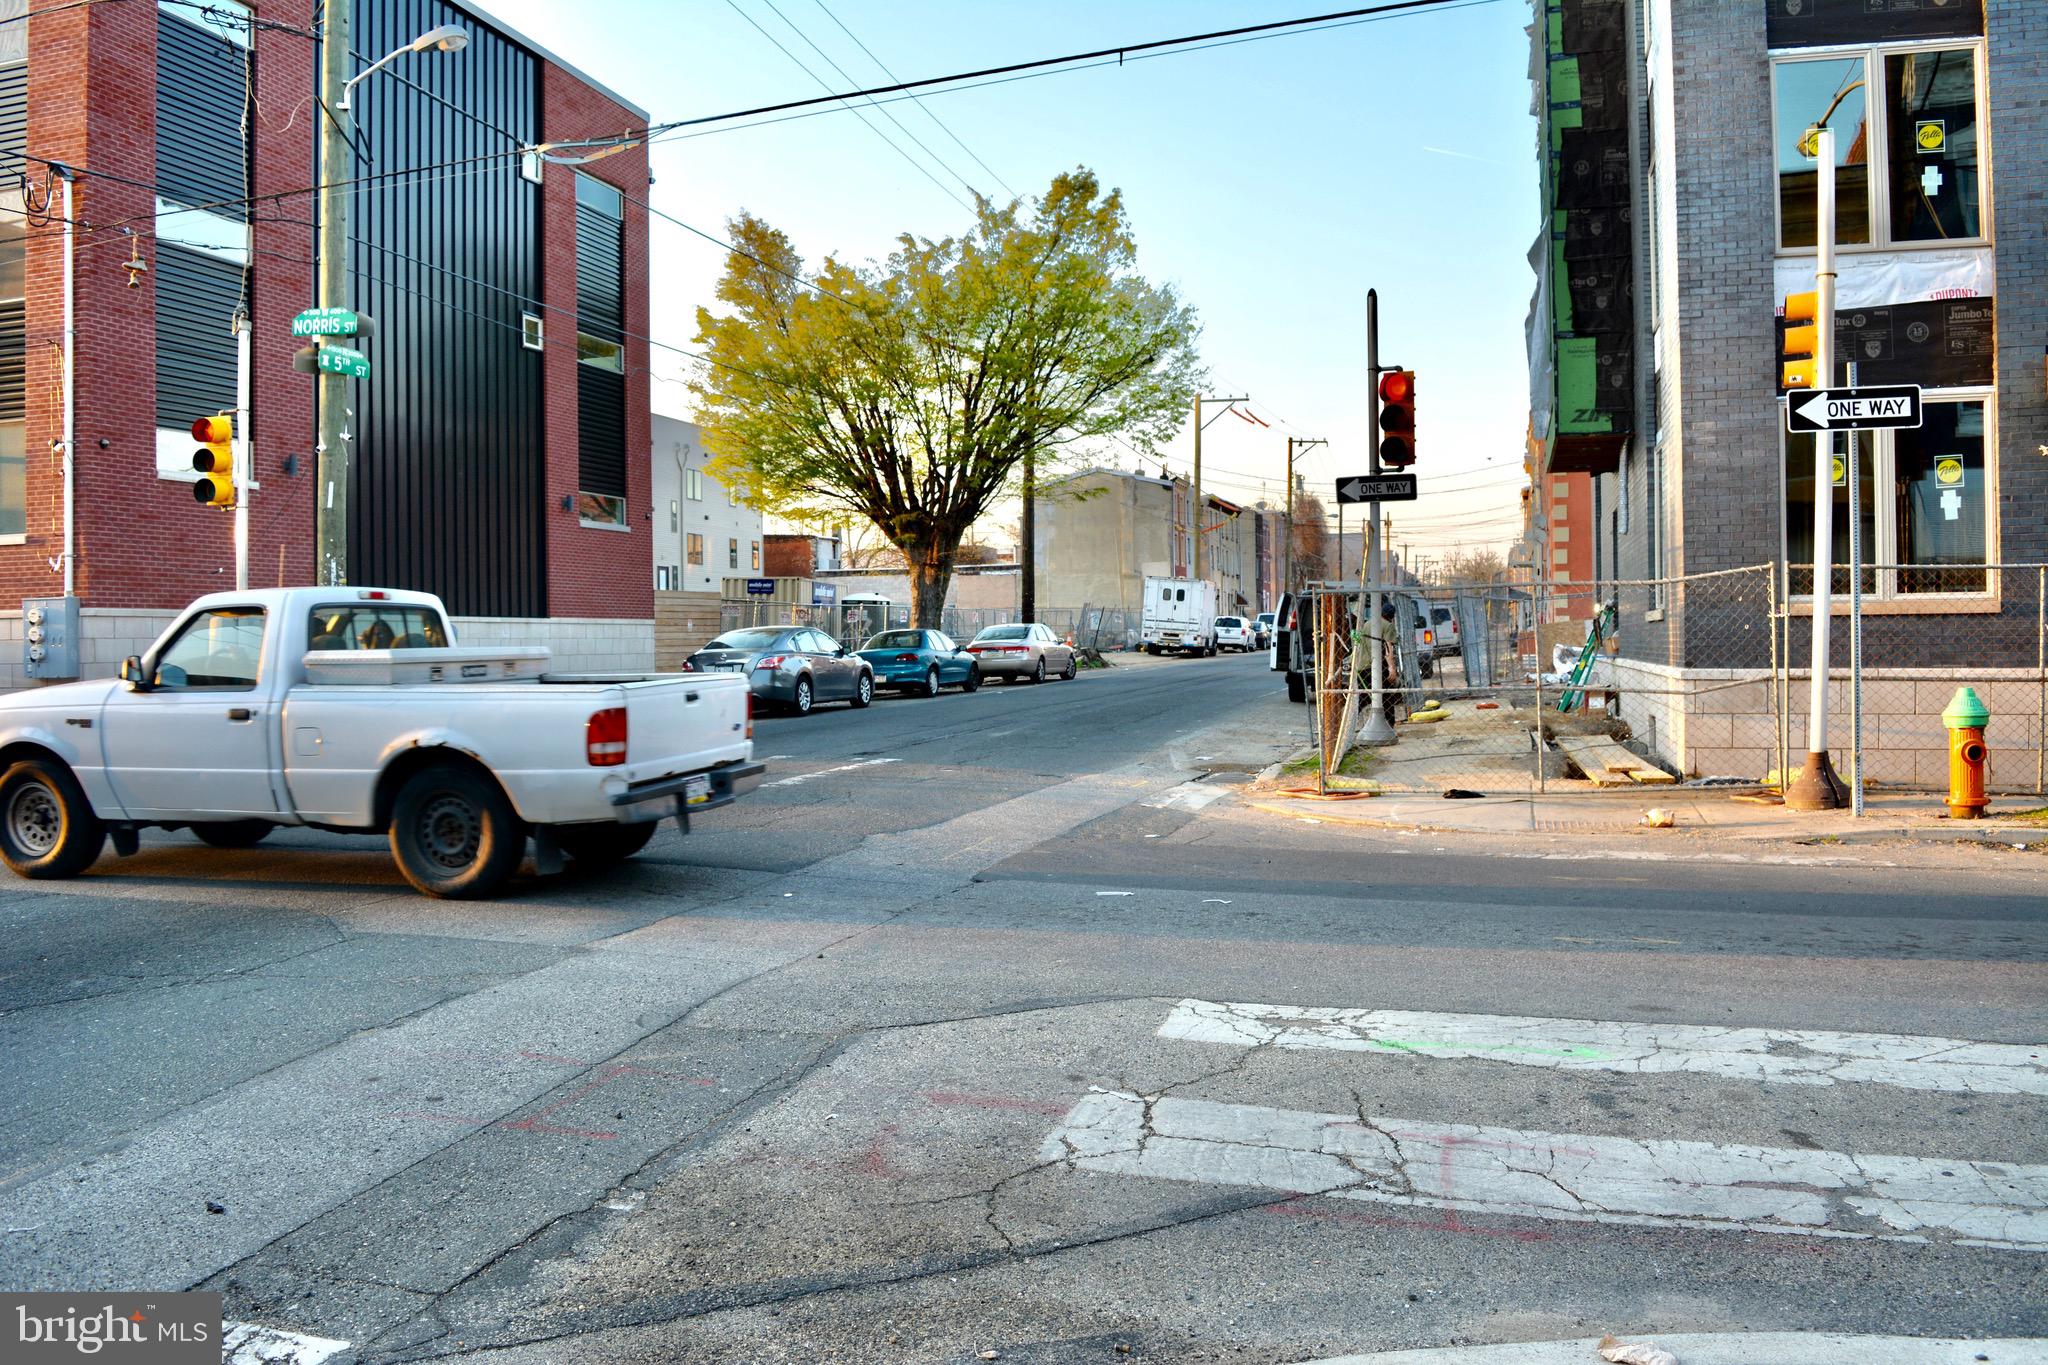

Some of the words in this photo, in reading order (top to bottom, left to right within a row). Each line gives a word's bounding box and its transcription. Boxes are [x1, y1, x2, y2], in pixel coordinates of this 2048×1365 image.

[1935, 288, 1974, 300] DUPONT
[1949, 309, 1982, 320] Jumbo
[1982, 308, 1993, 318] Te
[293, 317, 340, 335] NORRIS
[344, 321, 355, 333] ST
[1835, 317, 1851, 326] Tex
[355, 365, 367, 377] ST
[1827, 401, 1863, 417] ONE
[1868, 399, 1905, 416] WAY
[1360, 483, 1382, 494] ONE
[1386, 482, 1408, 493] WAY
